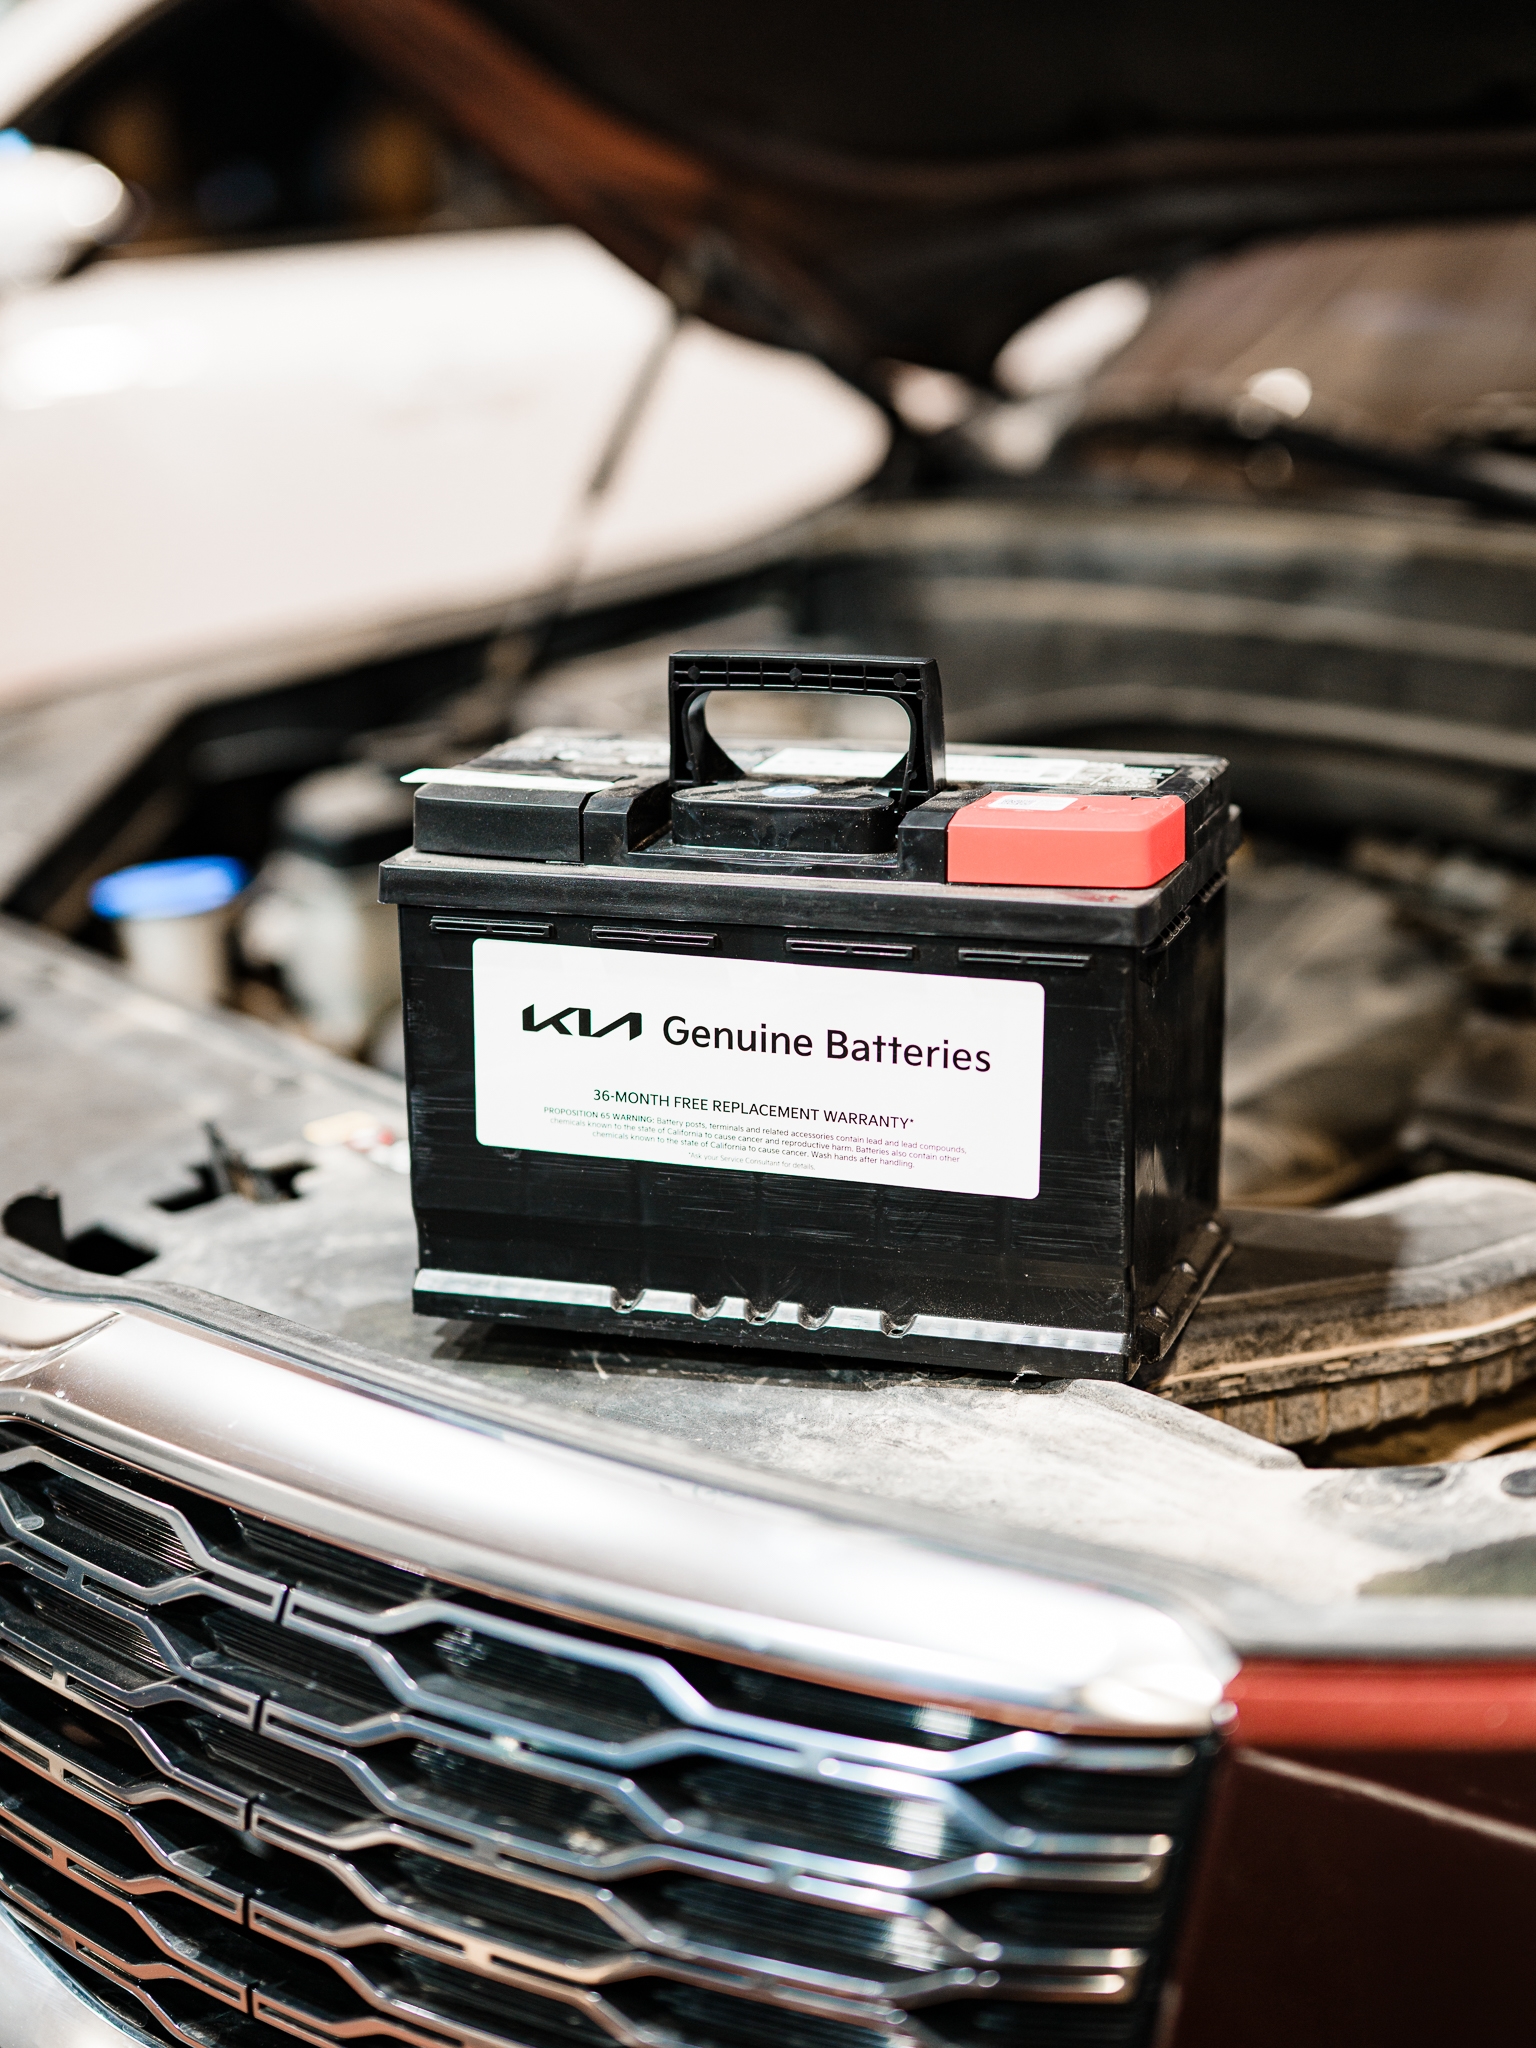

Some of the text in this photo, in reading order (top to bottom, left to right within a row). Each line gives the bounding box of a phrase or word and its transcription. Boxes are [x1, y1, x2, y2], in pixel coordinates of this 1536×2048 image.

[662, 1015, 813, 1057] Genuine
[827, 1029, 991, 1073] Batteries
[593, 1088, 670, 1107] 36-MONTH
[674, 1095, 708, 1111] FREE
[712, 1099, 819, 1121] REPLACEMENT
[543, 1106, 966, 1154] PROPOSITION 65 WARNING: Battery posts, terminals and related accessories contain lead and lead compounds,
[550, 1117, 585, 1126] chemicals
[587, 1120, 612, 1129] known
[623, 1123, 636, 1131] the
[637, 1125, 655, 1133] state
[657, 1126, 665, 1134] of
[666, 1127, 702, 1138] California
[704, 1131, 712, 1139] to
[713, 1133, 736, 1141] cause
[737, 1135, 763, 1143] cancer
[764, 1137, 779, 1145] and
[781, 1139, 830, 1150] reproductive
[831, 1143, 853, 1152] harm.
[855, 1145, 889, 1156] Batteries
[891, 1149, 907, 1158] also
[908, 1152, 937, 1160] contain
[939, 1154, 960, 1162] other
[591, 1130, 628, 1140] chemicals
[630, 1133, 655, 1142] known
[657, 1136, 665, 1144] to
[666, 1137, 678, 1145] the
[680, 1139, 699, 1147] state
[700, 1140, 708, 1148] of
[709, 1140, 746, 1152] California
[757, 1146, 780, 1155] cause
[781, 1149, 809, 1157] cancer.
[810, 1150, 832, 1159] Wash
[833, 1152, 857, 1162] hands
[859, 1155, 878, 1164] after
[879, 1157, 914, 1170] handling.
